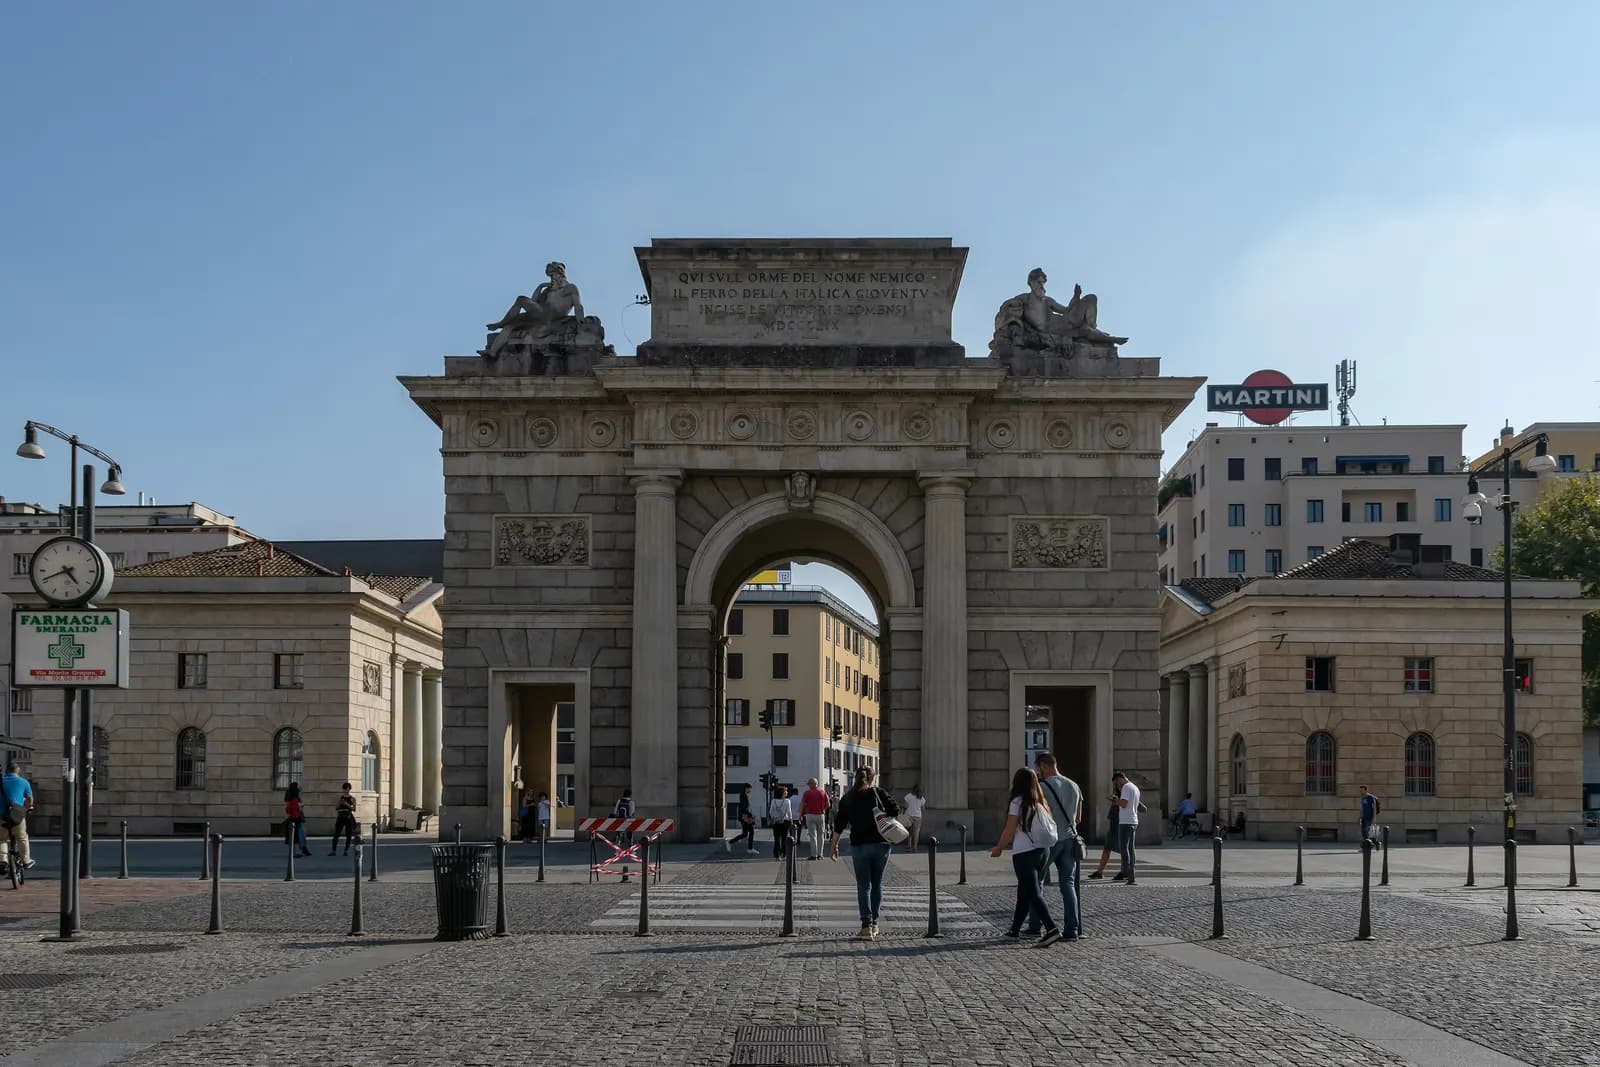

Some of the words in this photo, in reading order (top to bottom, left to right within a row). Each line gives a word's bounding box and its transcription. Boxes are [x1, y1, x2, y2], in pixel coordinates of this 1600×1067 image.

[679, 272, 704, 284] QVI
[748, 272, 789, 283] ORME
[793, 272, 817, 283] DEL
[824, 272, 865, 283] NOME
[869, 272, 925, 283] NEMICO
[673, 288, 688, 298] IL
[691, 288, 737, 298] FERRO
[743, 288, 788, 298] DELLA
[795, 288, 850, 299] ITALICA
[856, 288, 929, 299] GIOVENTV
[1214, 389, 1321, 405] MARTINI
[20, 615, 112, 625] FARMACIA
